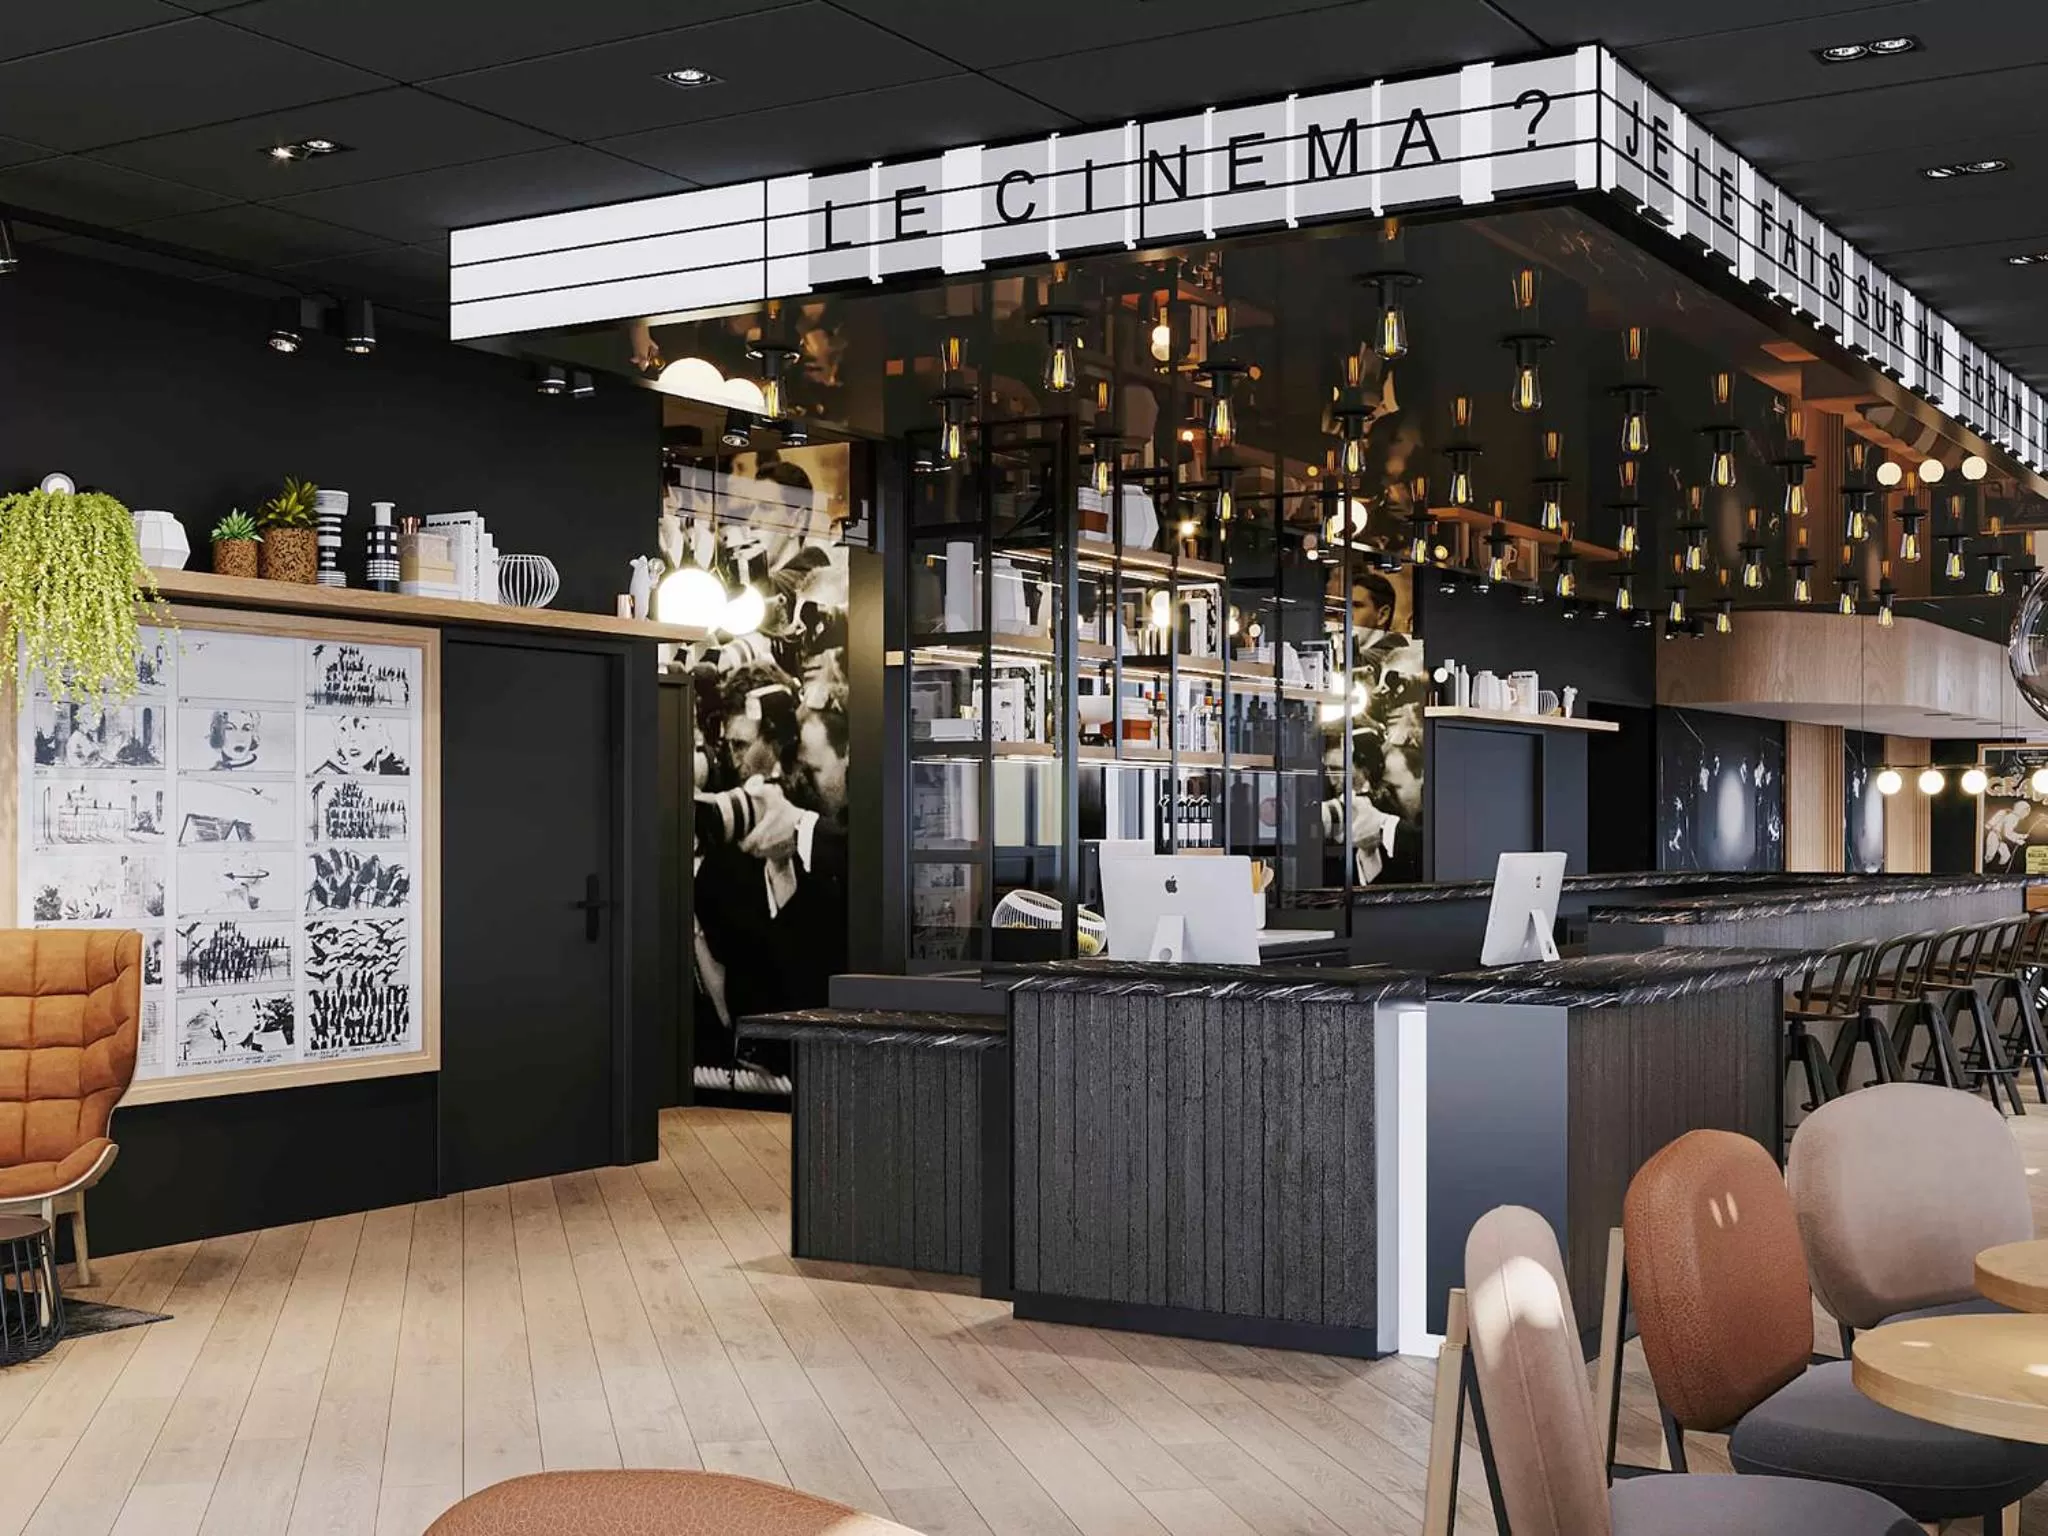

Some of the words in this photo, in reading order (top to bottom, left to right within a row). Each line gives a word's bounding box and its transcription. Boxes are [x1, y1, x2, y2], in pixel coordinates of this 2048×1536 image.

[825, 186, 927, 249] LE
[996, 107, 1443, 225] CINEMA
[1513, 89, 1551, 150] ?
[1626, 101, 1669, 180] JE
[1694, 147, 1734, 226] LE
[1761, 199, 1840, 301] FAIS
[1858, 275, 1904, 346] SUR
[1918, 319, 1944, 375] UN
